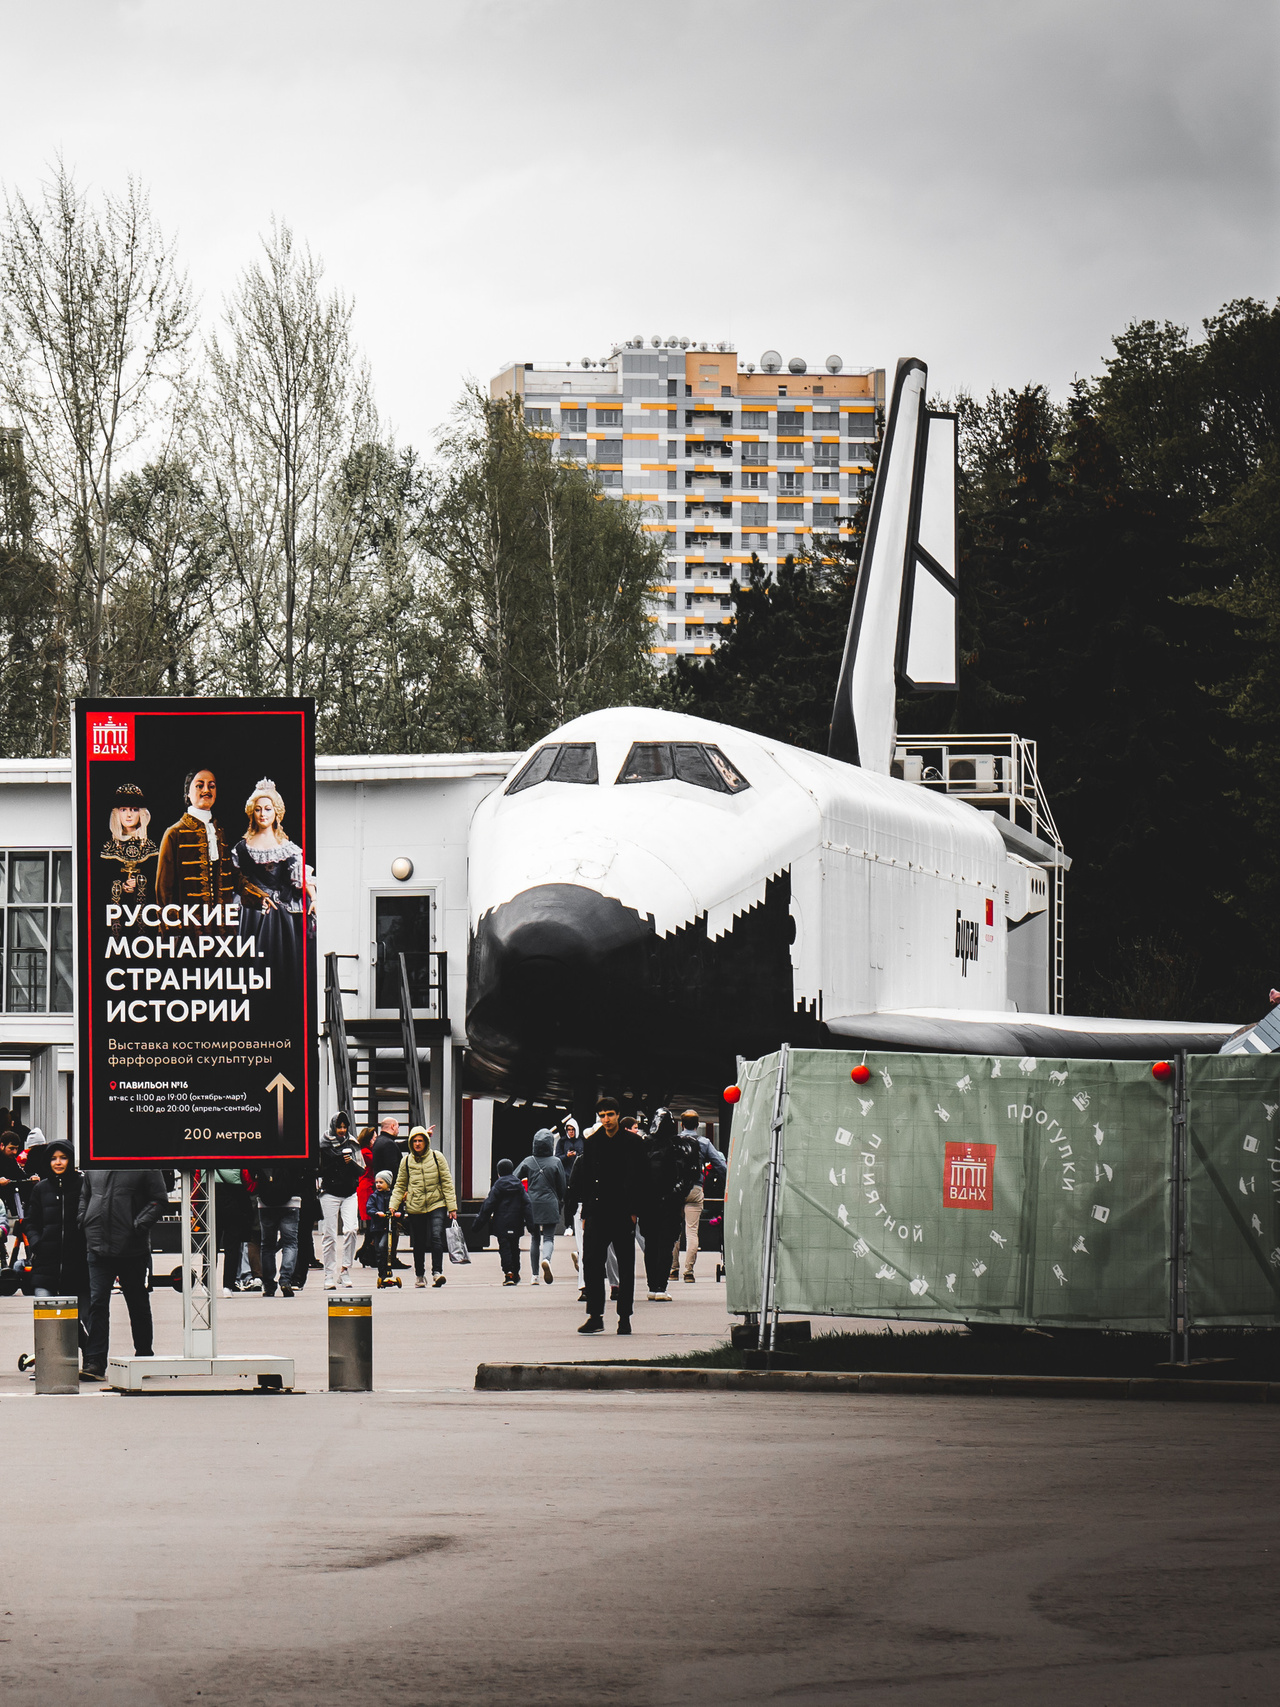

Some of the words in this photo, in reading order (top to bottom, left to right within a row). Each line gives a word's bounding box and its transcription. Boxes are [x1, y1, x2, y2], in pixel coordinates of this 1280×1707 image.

[93, 744, 128, 754] ВДНХ
[106, 904, 239, 927] РУССКИЕ
[105, 936, 264, 958] МОНАРХИ.
[106, 967, 271, 994] СТРАНИЦЫ
[107, 999, 250, 1023] ИСТОРИИ
[108, 1038, 169, 1050] Выставка
[172, 1038, 291, 1051] костюмированной
[108, 1054, 193, 1067] фарфоровой
[197, 1054, 272, 1066] скульптуры
[119, 1081, 169, 1090] ПАВИЛЬОН
[170, 1081, 189, 1089] №16
[136, 1093, 155, 1101] 11:00
[167, 1093, 188, 1101] 19:00
[189, 1091, 247, 1102] (октябрь-март)
[135, 1104, 155, 1112] 11:00
[166, 1104, 190, 1112] 20:00
[191, 1103, 262, 1113] (апрель-сентябрь)
[184, 1128, 212, 1140] 200
[215, 1130, 262, 1142] метров
[861, 1133, 923, 1243] приятной
[1007, 1103, 1077, 1192] прогулки
[949, 1187, 987, 1201] ВДНХ
